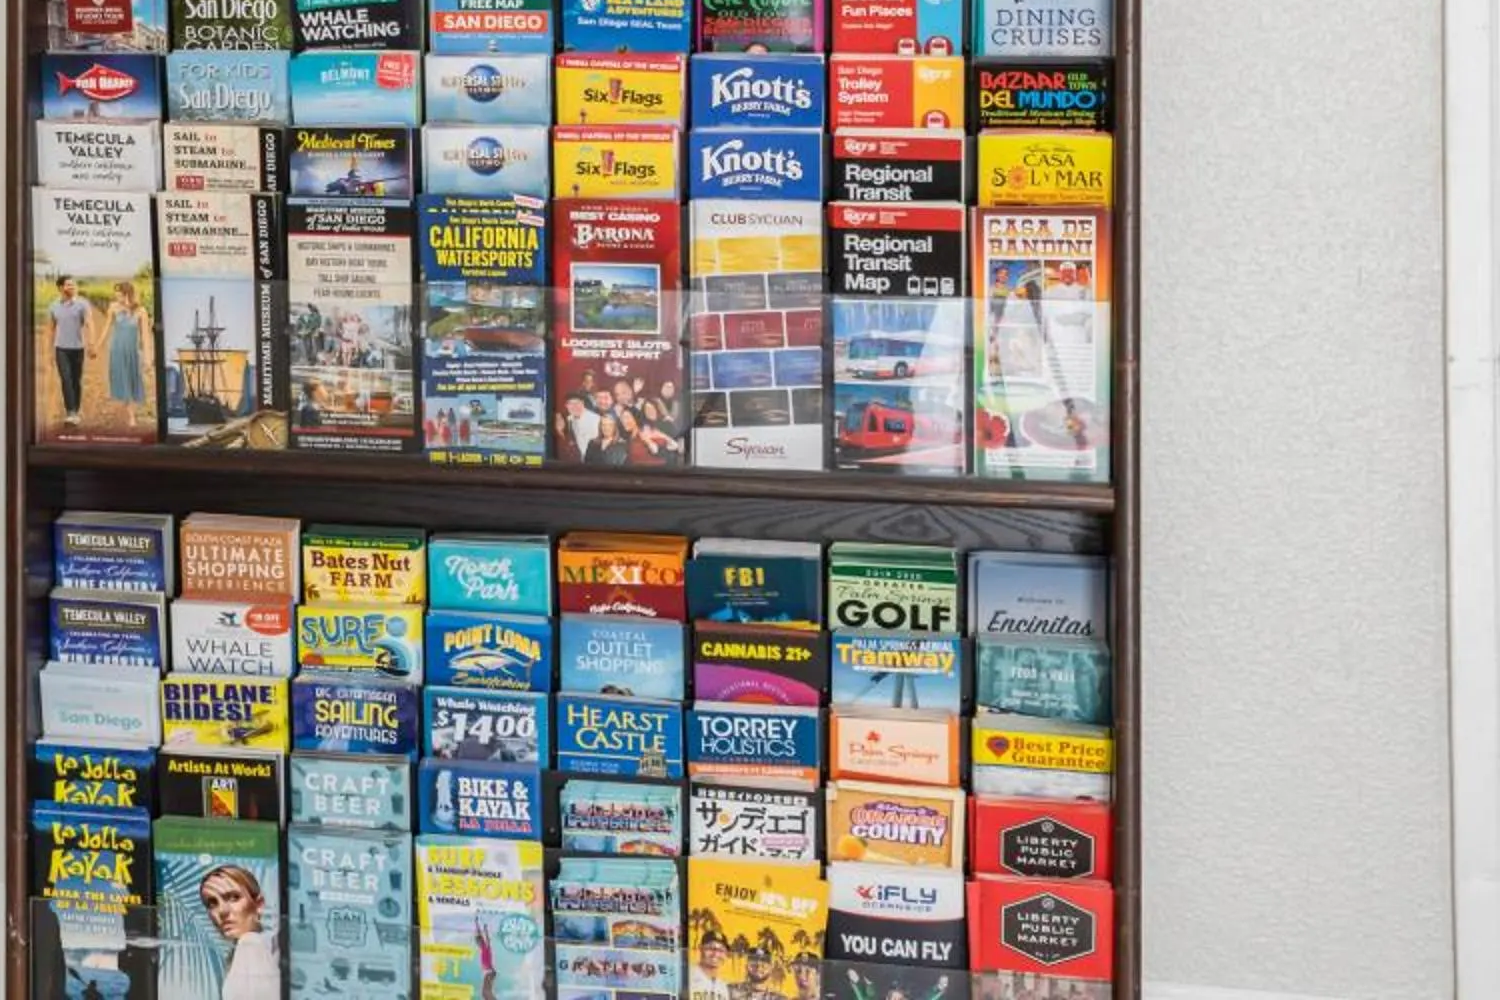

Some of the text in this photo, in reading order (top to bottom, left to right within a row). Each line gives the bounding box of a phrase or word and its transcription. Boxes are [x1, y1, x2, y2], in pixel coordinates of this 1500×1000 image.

[300, 9, 369, 25] WHALE
[841, 5, 913, 18] Fun Places
[996, 10, 1096, 27] DINING
[444, 14, 541, 29] SAN DIEGO
[184, 25, 279, 41] BOTANIC
[301, 22, 401, 41] WATCHING
[991, 28, 1101, 46] CRUISES
[711, 67, 811, 108] Knott's
[838, 78, 882, 92] Trolley
[980, 72, 1065, 90] BAZAAR
[584, 88, 663, 106] Six Flags
[838, 91, 889, 104] System
[980, 90, 1096, 109] DEL MUNDO
[56, 131, 135, 146] TEMECULA
[298, 131, 395, 151] Medieval Times
[69, 145, 124, 159] VALLEY
[702, 140, 803, 182] Knott's
[1023, 154, 1076, 168] CASA
[576, 162, 656, 178] Six Flags
[845, 166, 933, 186] Regional
[1056, 170, 1103, 187] MAR
[845, 186, 912, 201] Transit
[54, 197, 135, 213] TEMECULA
[165, 199, 193, 209] SAIL
[67, 213, 122, 227] VALLEY
[165, 212, 210, 223] STEAM
[316, 213, 386, 225] SAN DIEGO
[711, 213, 803, 226] CLUB SYCUAN
[429, 225, 538, 249] CALIFORNIA
[574, 222, 655, 249] BARONA
[844, 235, 933, 254] Regional
[988, 238, 1093, 257] BANDINI
[436, 248, 533, 269] WATERSPORTS
[844, 255, 912, 272] Transit
[844, 274, 891, 294] Map
[258, 200, 273, 407] MARITIME MUSEUM SAN DIEGO
[187, 546, 285, 564] ULTIMATE
[311, 551, 411, 572] Bates Nut
[187, 560, 285, 579] SHOPPING
[724, 566, 765, 588] FBI
[329, 571, 394, 589] FARM
[837, 599, 951, 632] GOLF
[987, 609, 1095, 637] Encinitas
[301, 614, 378, 653] SURF
[444, 624, 541, 661] POINT LOMA
[186, 638, 271, 657] WHALE
[587, 640, 653, 656] OUTLET
[701, 642, 782, 660] CANNABIS
[836, 644, 954, 670] Tramway
[188, 655, 274, 675] WATCH
[576, 655, 665, 674] SHOPPING
[165, 702, 252, 722] RIDES!
[315, 701, 398, 727] SAILING
[567, 704, 669, 733] HEARST
[698, 716, 799, 739] TORREY
[575, 727, 667, 754] CASTLE
[701, 736, 796, 758] HOLISTICS
[1013, 736, 1106, 756] Best Price
[167, 759, 212, 774] Artists
[1012, 752, 1107, 769] Guarantee
[212, 778, 235, 791] ART
[305, 772, 390, 795] CRAFT
[458, 776, 508, 800] BIKE
[313, 792, 381, 816] BEER
[458, 799, 532, 821] KAYAK
[695, 801, 809, 835] サンディエゴ
[852, 824, 948, 845] COUNTY
[1016, 835, 1080, 848] LIBERTY
[699, 836, 758, 854] ガイド
[1020, 846, 1074, 858] PUBLIC
[302, 847, 387, 870] CRAFT
[1016, 856, 1076, 869] MARKET
[312, 869, 380, 892] BEER
[715, 883, 757, 901] ENJOY
[877, 885, 938, 902] iFLY
[1017, 912, 1080, 925] LIBERTY
[1020, 923, 1075, 935] PUBLIC
[841, 934, 953, 961] YOU CAN FLY
[1017, 933, 1078, 947] MARKET
